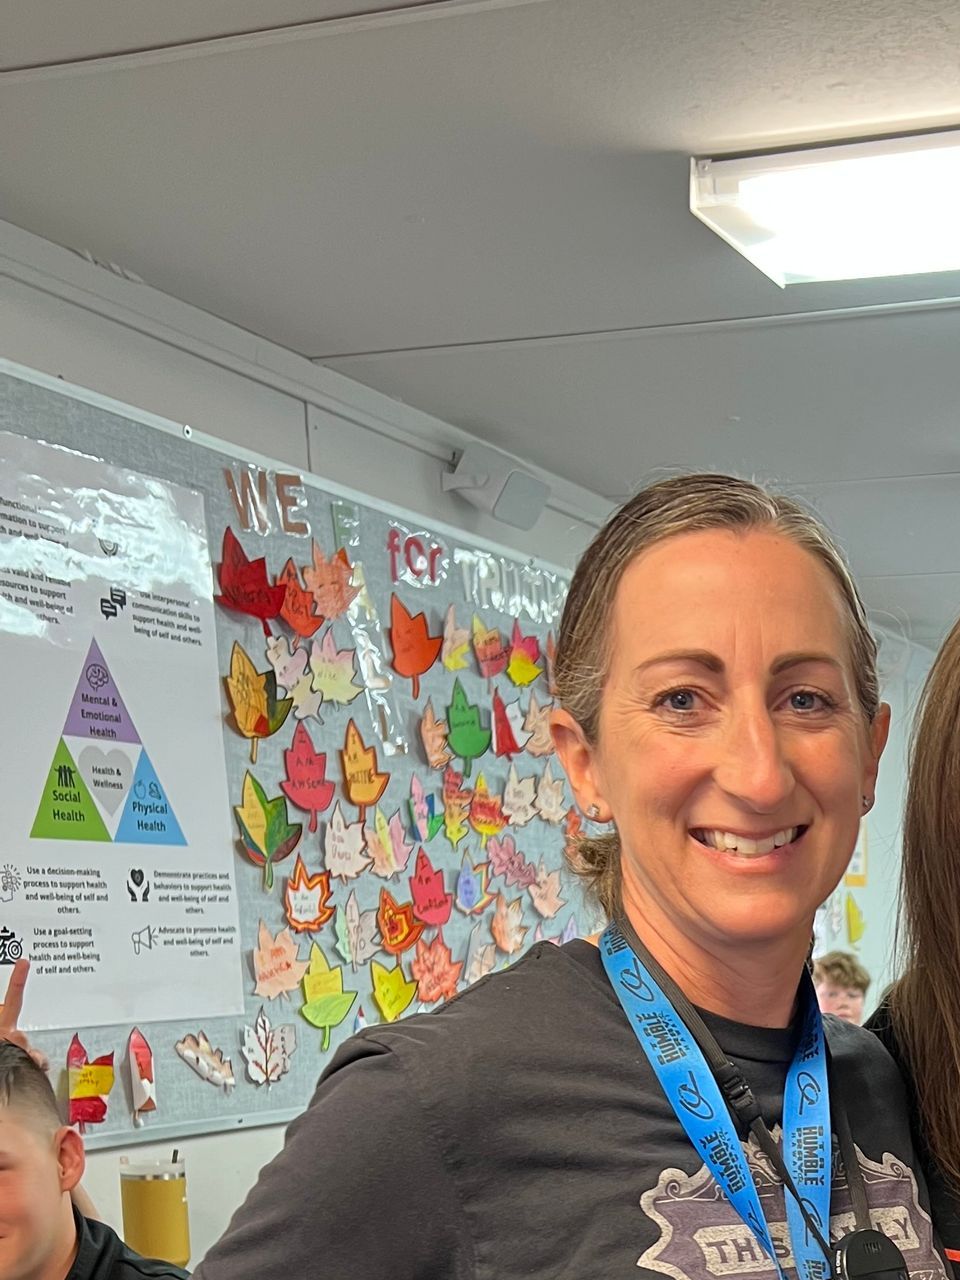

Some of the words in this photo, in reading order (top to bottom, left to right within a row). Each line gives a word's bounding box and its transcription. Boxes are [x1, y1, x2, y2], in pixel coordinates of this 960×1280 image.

[224, 468, 310, 537] WE
[81, 693, 110, 706] Mental
[112, 697, 118, 707] &
[81, 709, 122, 723] Emotional
[90, 726, 116, 738] Health
[92, 766, 115, 776] Health
[116, 768, 122, 776] &
[93, 780, 123, 790] Wellness
[53, 790, 81, 803] Social
[132, 802, 168, 816] Physical
[53, 810, 85, 822] Health
[137, 820, 166, 832] Health
[26, 866, 40, 874] Use
[47, 868, 101, 878] decision-making
[23, 881, 50, 889] process
[50, 880, 58, 888] to
[59, 881, 85, 890] support
[86, 881, 108, 889] health
[26, 892, 38, 900] and
[40, 892, 74, 902] well-being
[76, 892, 82, 900] of
[96, 893, 108, 902] and
[57, 906, 80, 914] others.
[34, 928, 46, 936] Use
[54, 926, 92, 937] goal-setting
[33, 942, 59, 950] process
[69, 940, 94, 949] support
[67, 952, 100, 962] well-being
[36, 966, 44, 974] of
[44, 966, 57, 974] self
[648, 1011, 682, 1066] HUMBLE
[708, 1130, 746, 1193] HUMBLE
[803, 1126, 818, 1185] HUMBLE
